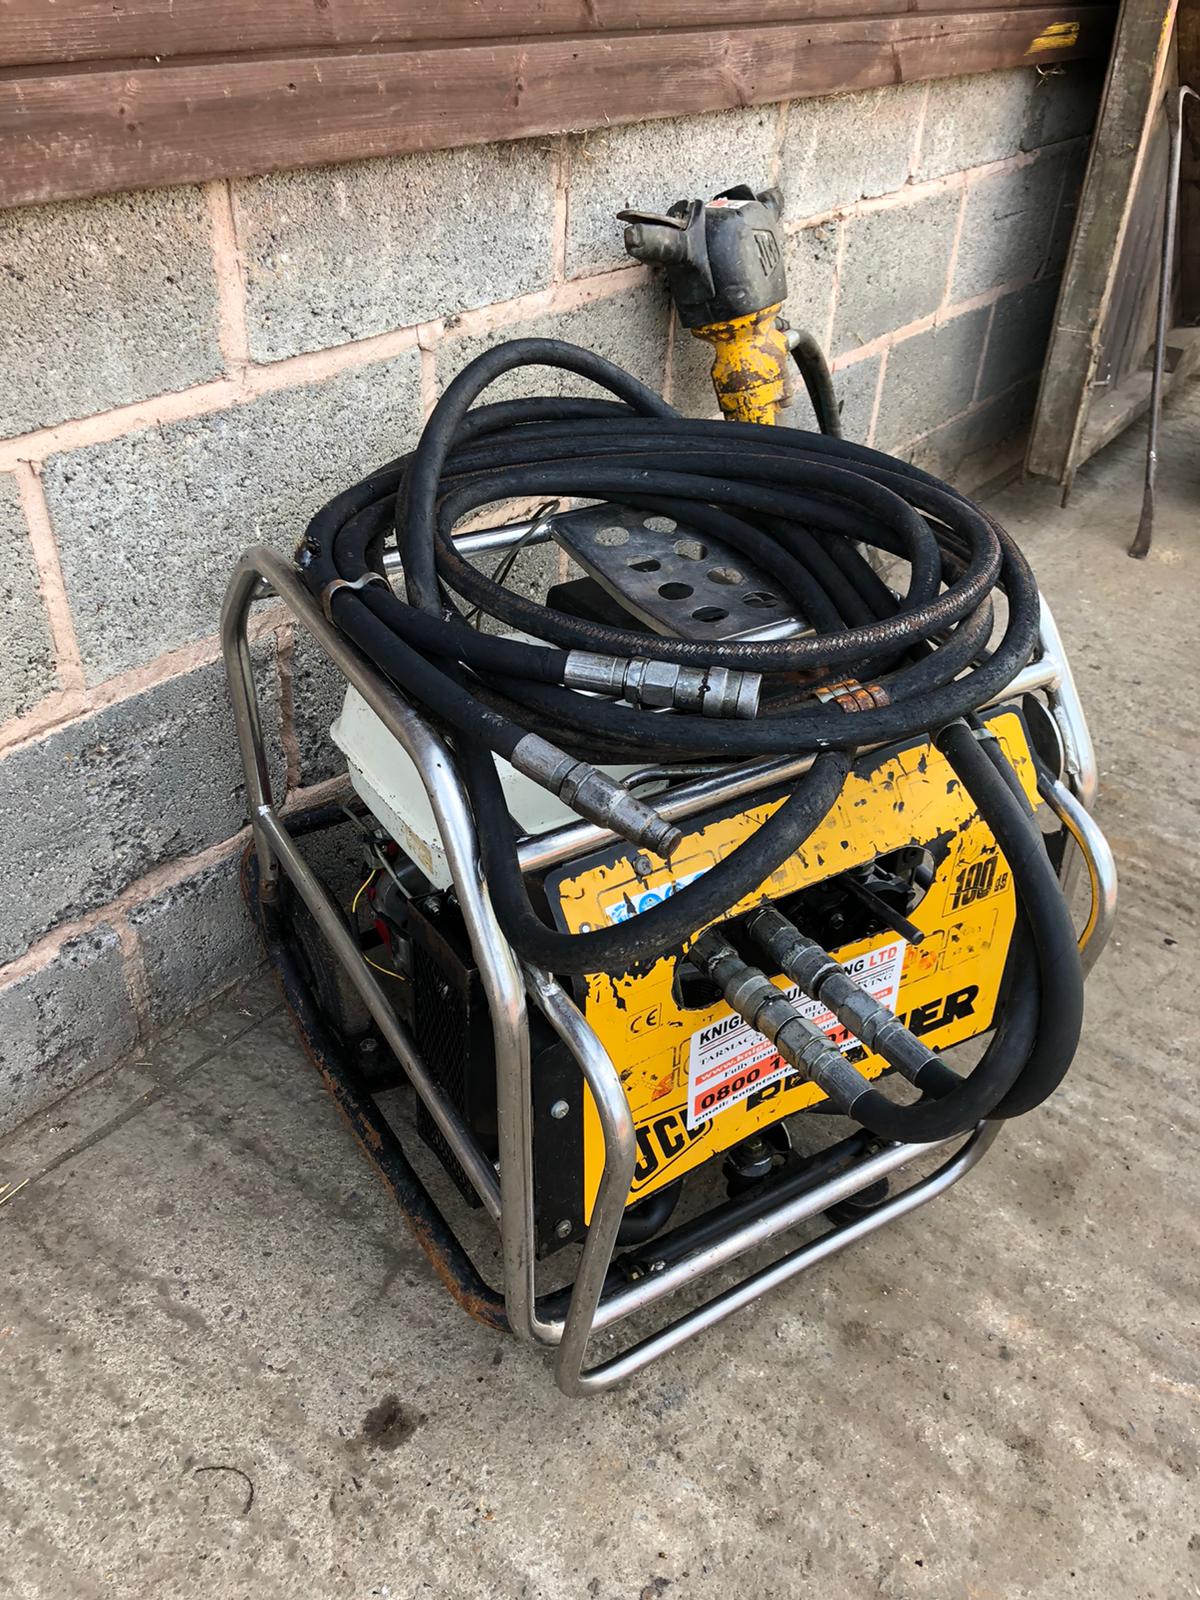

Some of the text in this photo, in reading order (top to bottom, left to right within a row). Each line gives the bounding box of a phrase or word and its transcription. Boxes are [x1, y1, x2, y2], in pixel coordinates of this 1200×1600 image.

[952, 855, 998, 910] 100
[868, 946, 897, 967] LTD
[700, 1068, 760, 1110] 0800
